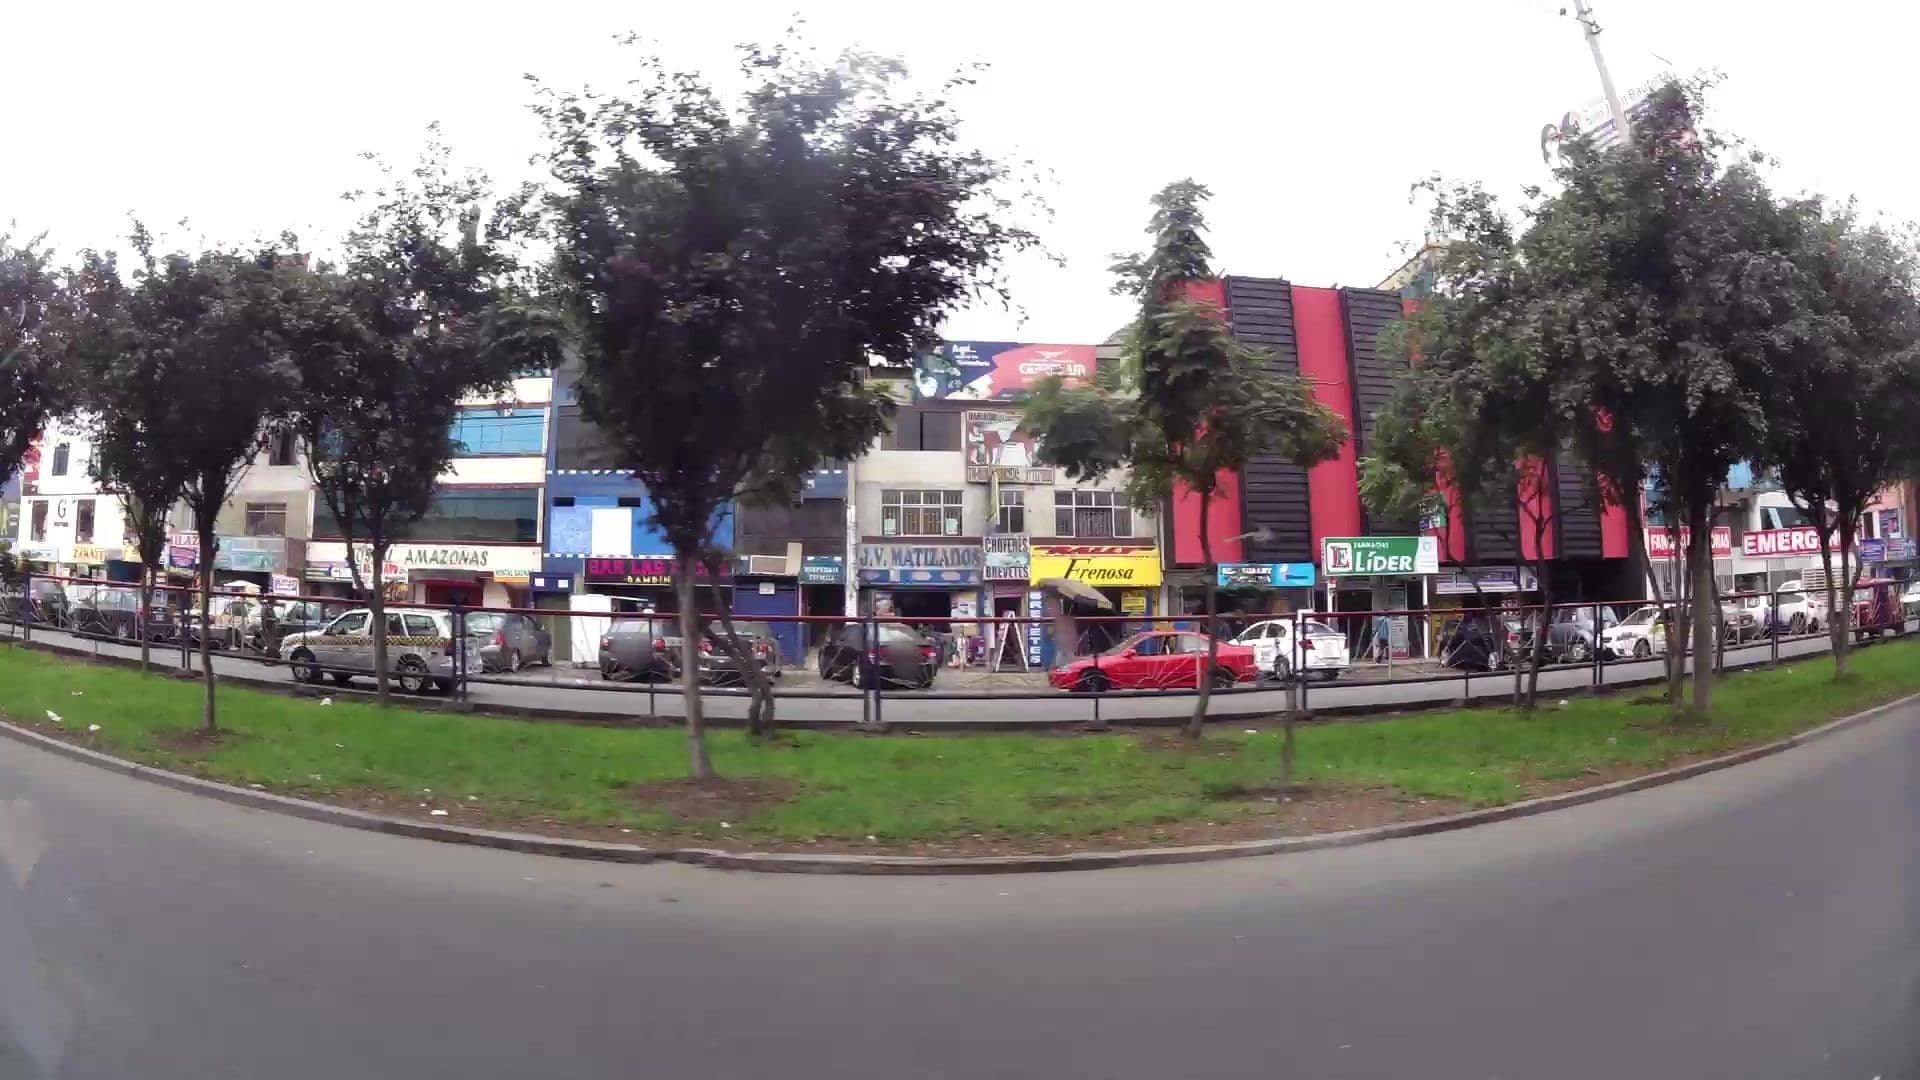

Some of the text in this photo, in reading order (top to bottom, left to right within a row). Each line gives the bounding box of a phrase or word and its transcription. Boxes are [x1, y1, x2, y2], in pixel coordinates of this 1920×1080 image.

[985, 537, 1028, 553] CHOFERES
[404, 549, 489, 567] AMAZONAS
[1063, 558, 1135, 580] Frenosa
